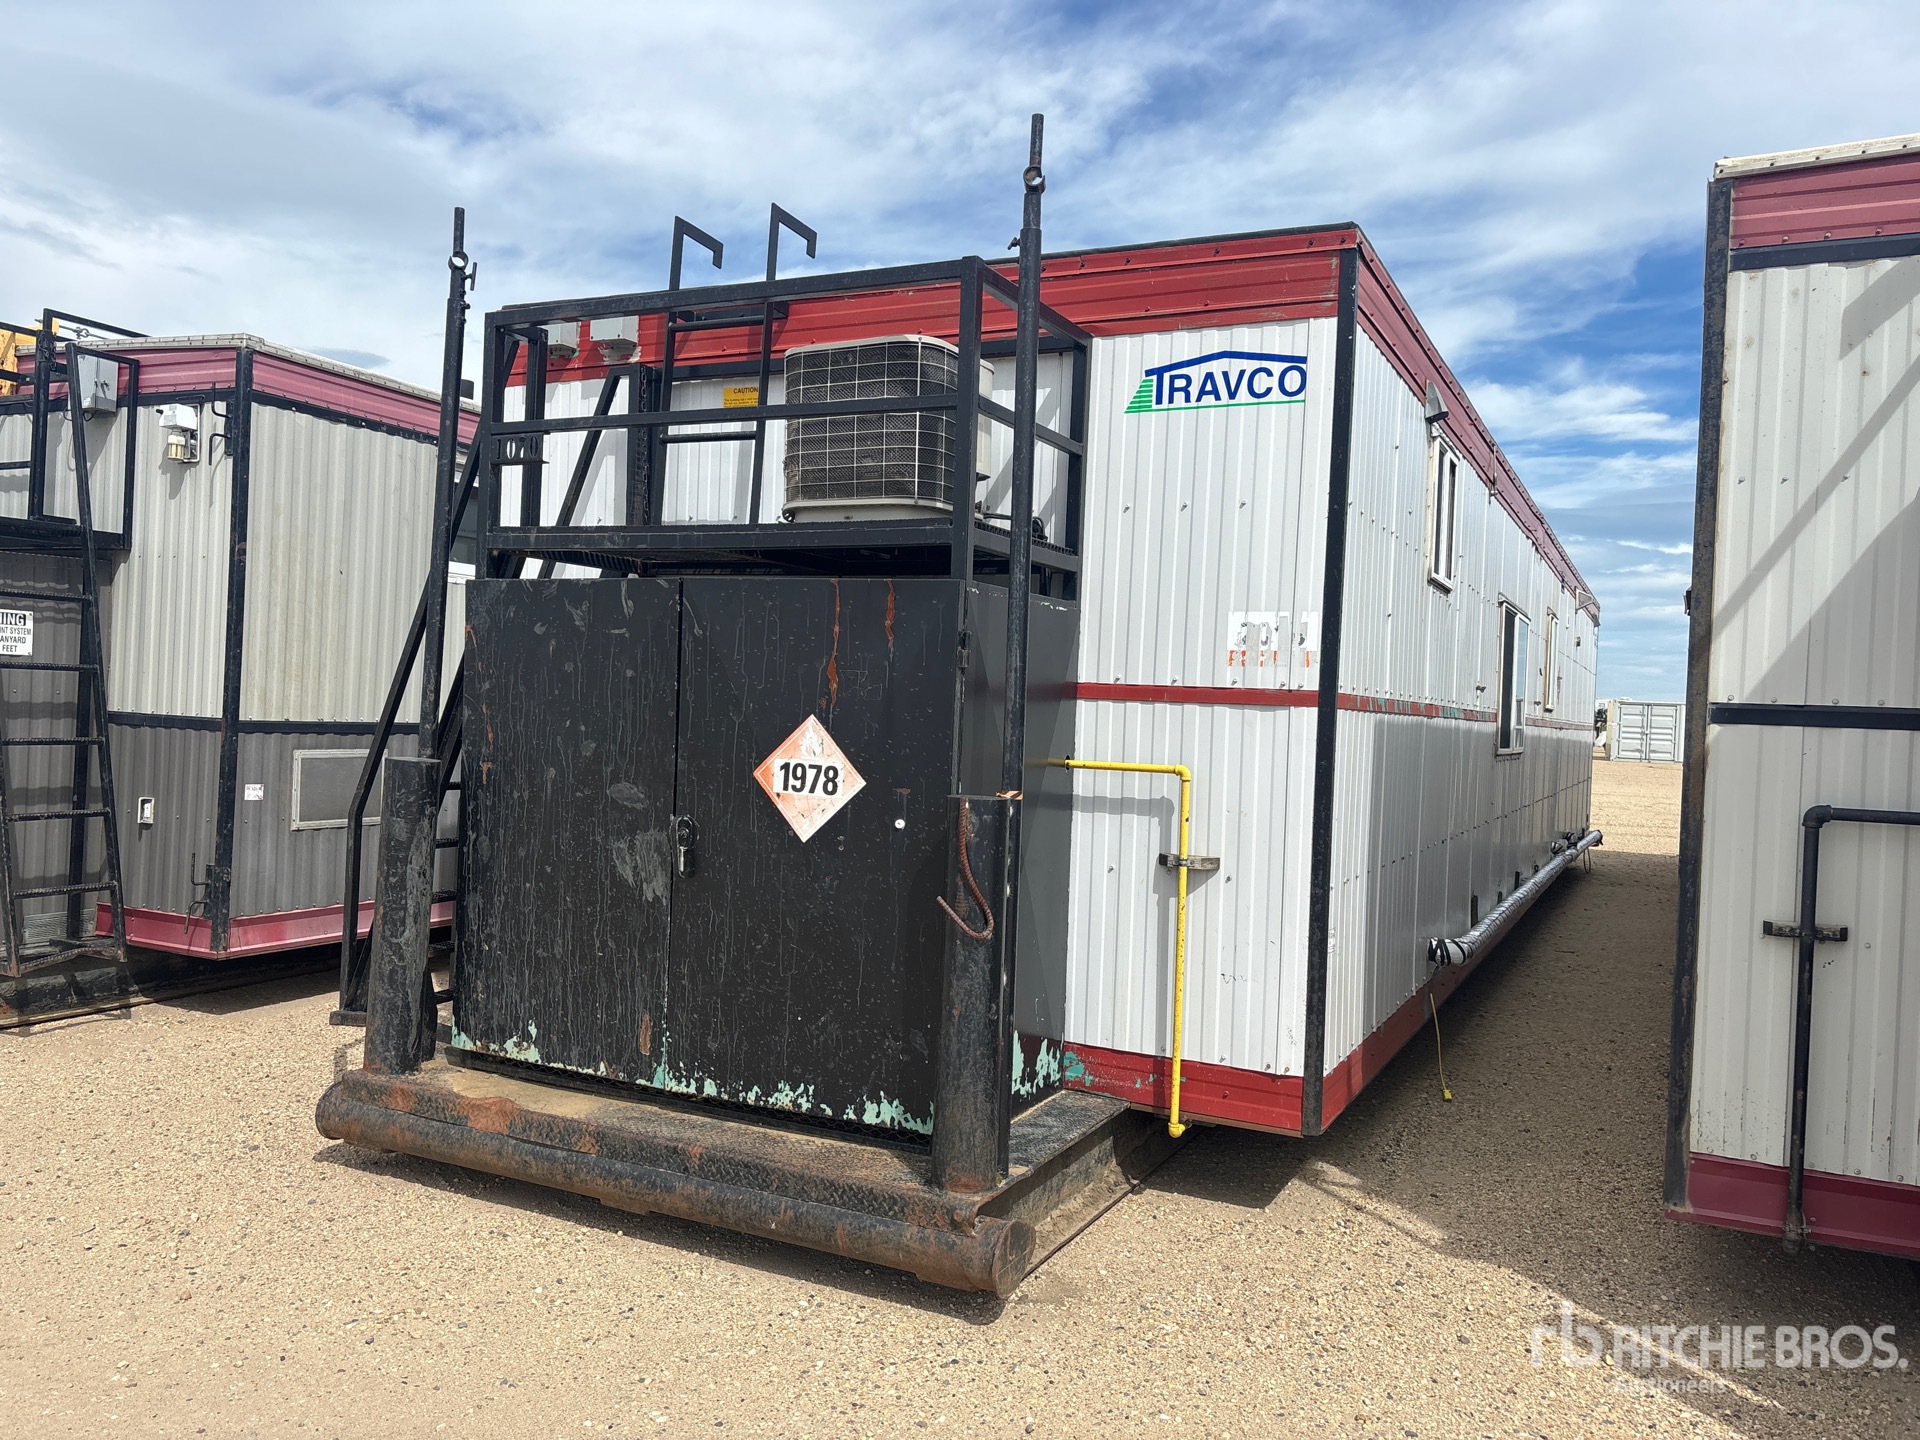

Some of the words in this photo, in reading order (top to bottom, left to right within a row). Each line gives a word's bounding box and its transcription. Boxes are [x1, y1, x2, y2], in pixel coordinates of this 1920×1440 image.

[1145, 364, 1307, 405] TRAVCO
[496, 436, 539, 459] 1070
[10, 627, 31, 636] SYSTEM
[780, 762, 838, 796] 1978
